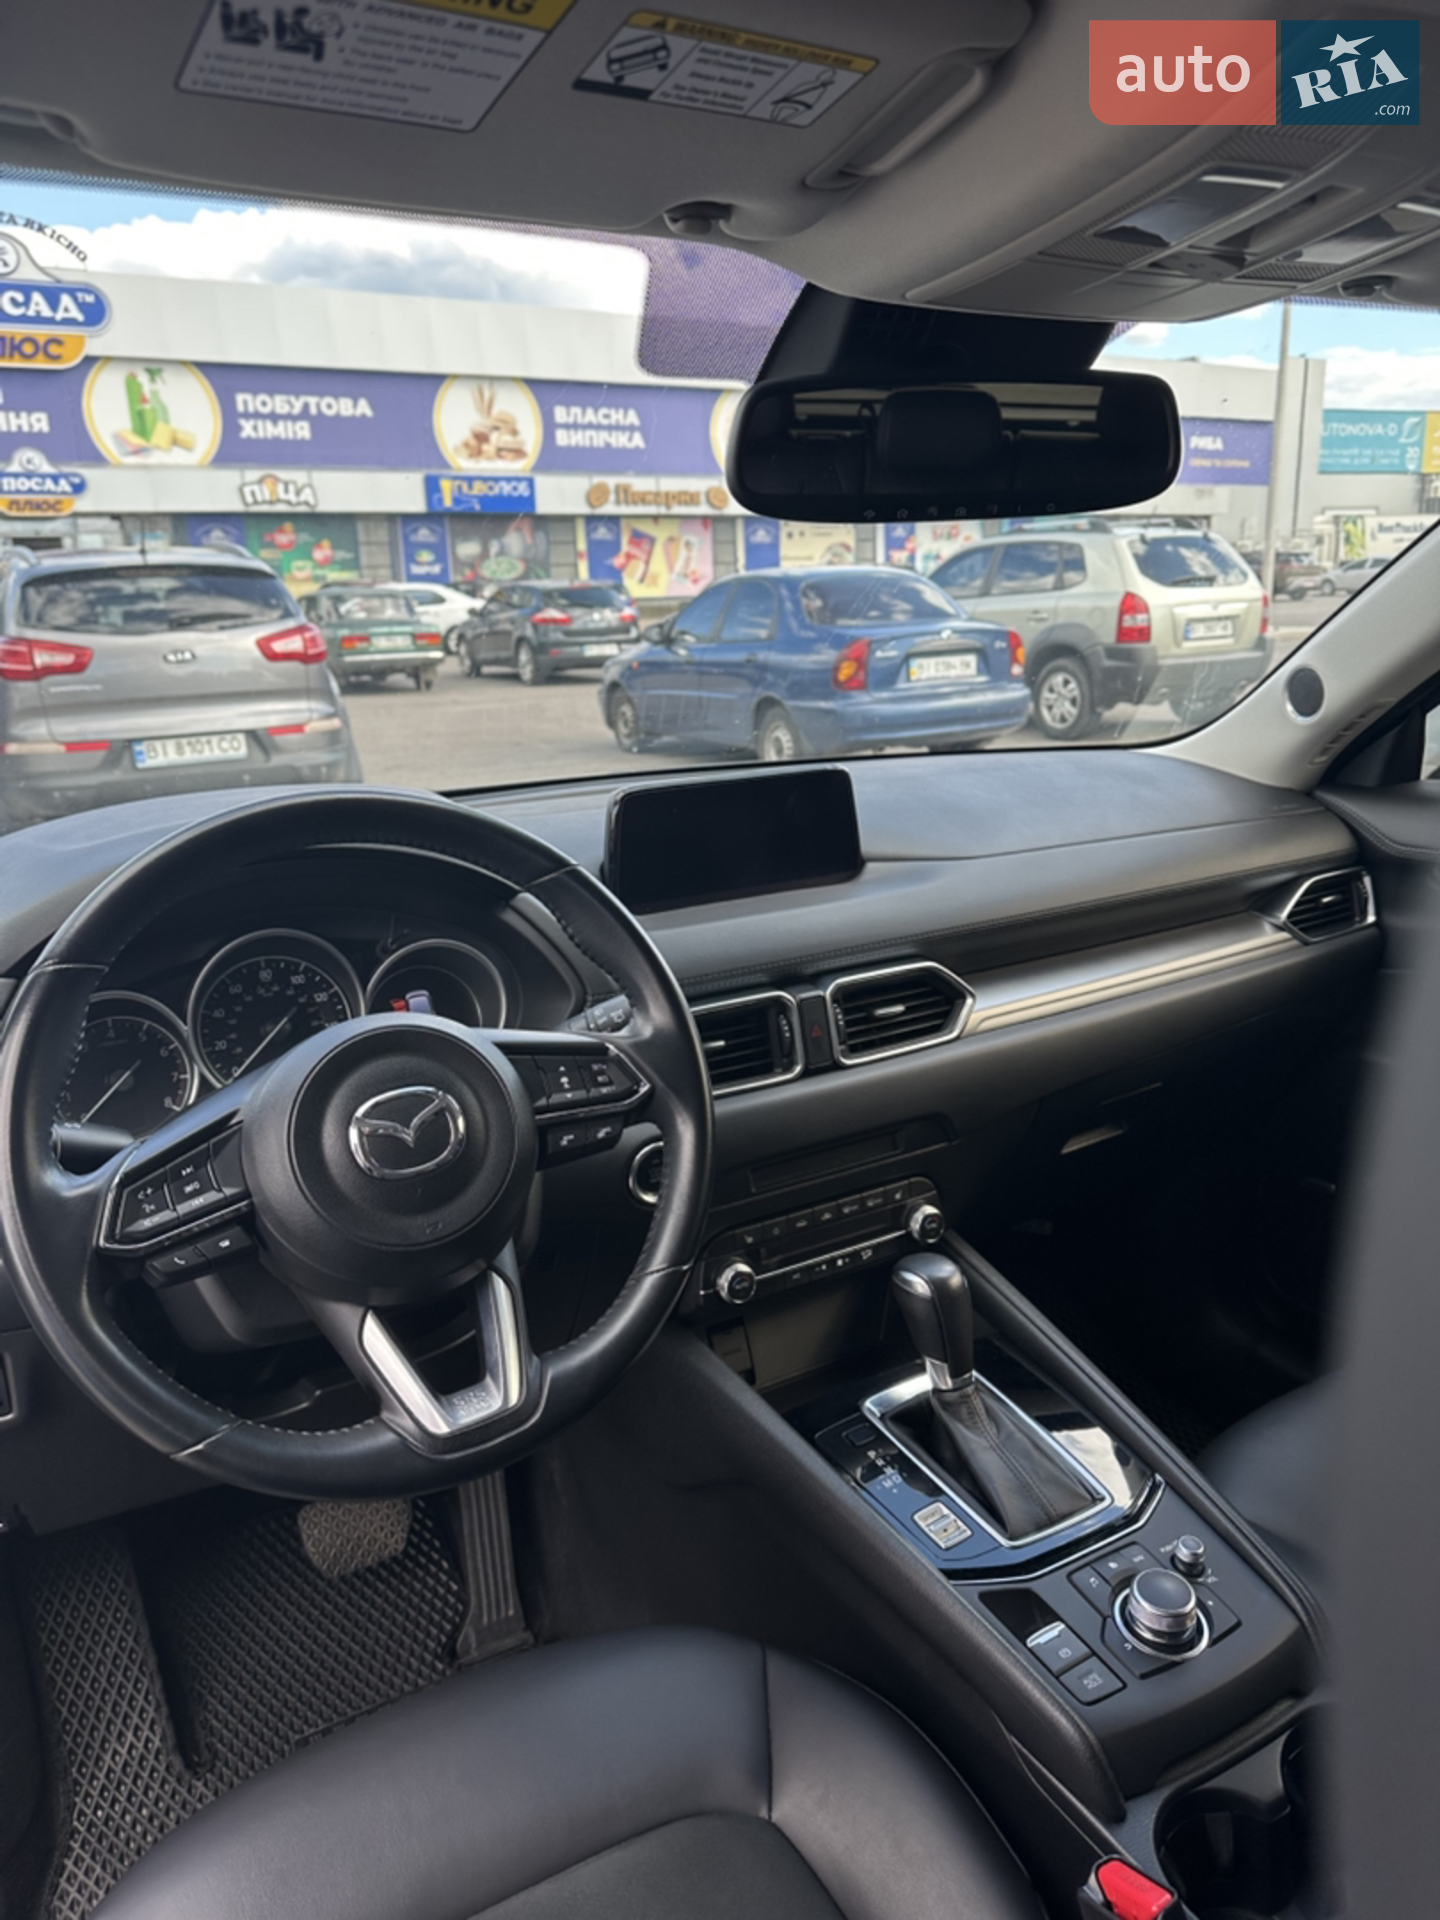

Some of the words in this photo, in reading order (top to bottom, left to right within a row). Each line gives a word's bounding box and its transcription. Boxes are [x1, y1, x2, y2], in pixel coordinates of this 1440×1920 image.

[0, 290, 85, 323] САД
[235, 392, 374, 418] ПОБУТОВА
[553, 405, 641, 427] ВЛАСНА
[238, 419, 312, 440] ХІМІЯ
[555, 428, 646, 449] ВИПІЧКА
[2, 475, 74, 495] ПОСАД
[8, 499, 64, 512] ПЛЮС
[229, 983, 242, 995] 60
[289, 973, 306, 985] 100
[159, 1046, 170, 1058] 6
[214, 1039, 227, 1052] 20
